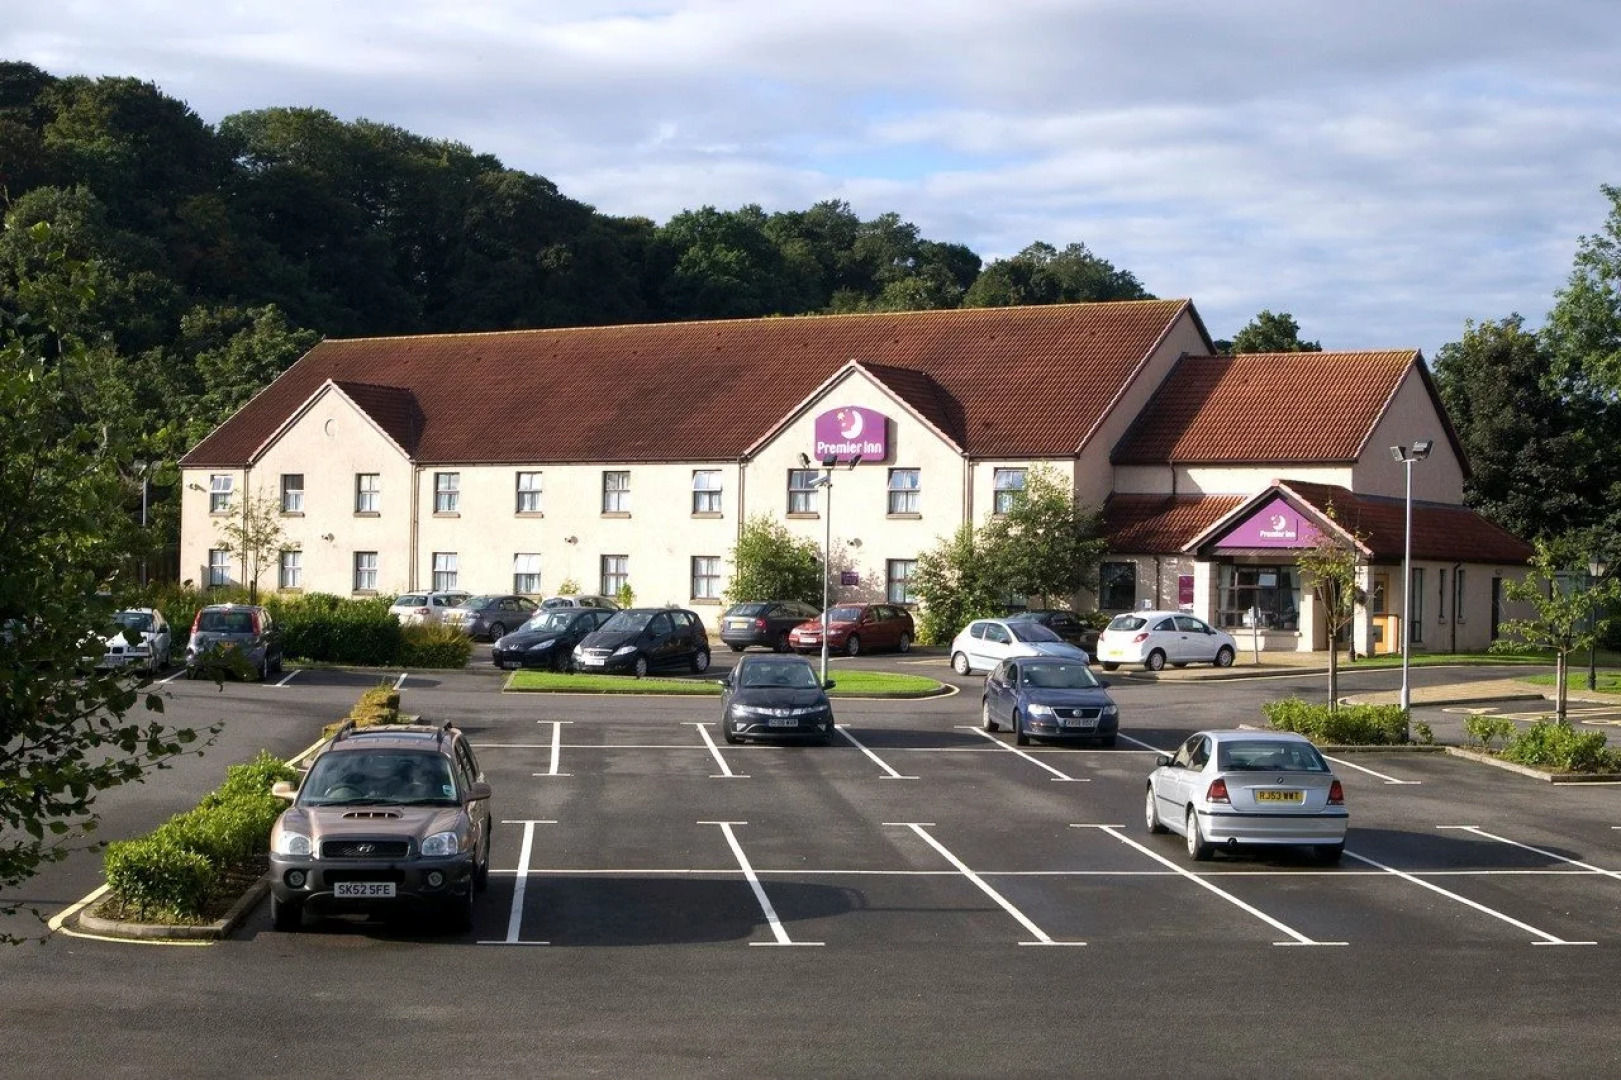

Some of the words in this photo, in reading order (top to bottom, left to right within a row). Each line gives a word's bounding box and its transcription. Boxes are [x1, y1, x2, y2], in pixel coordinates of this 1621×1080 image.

[817, 441, 862, 454] Premier
[863, 440, 882, 454] Inn
[1259, 791, 1281, 800] RJ53
[338, 884, 367, 895] SK52
[369, 884, 391, 895] SFE
